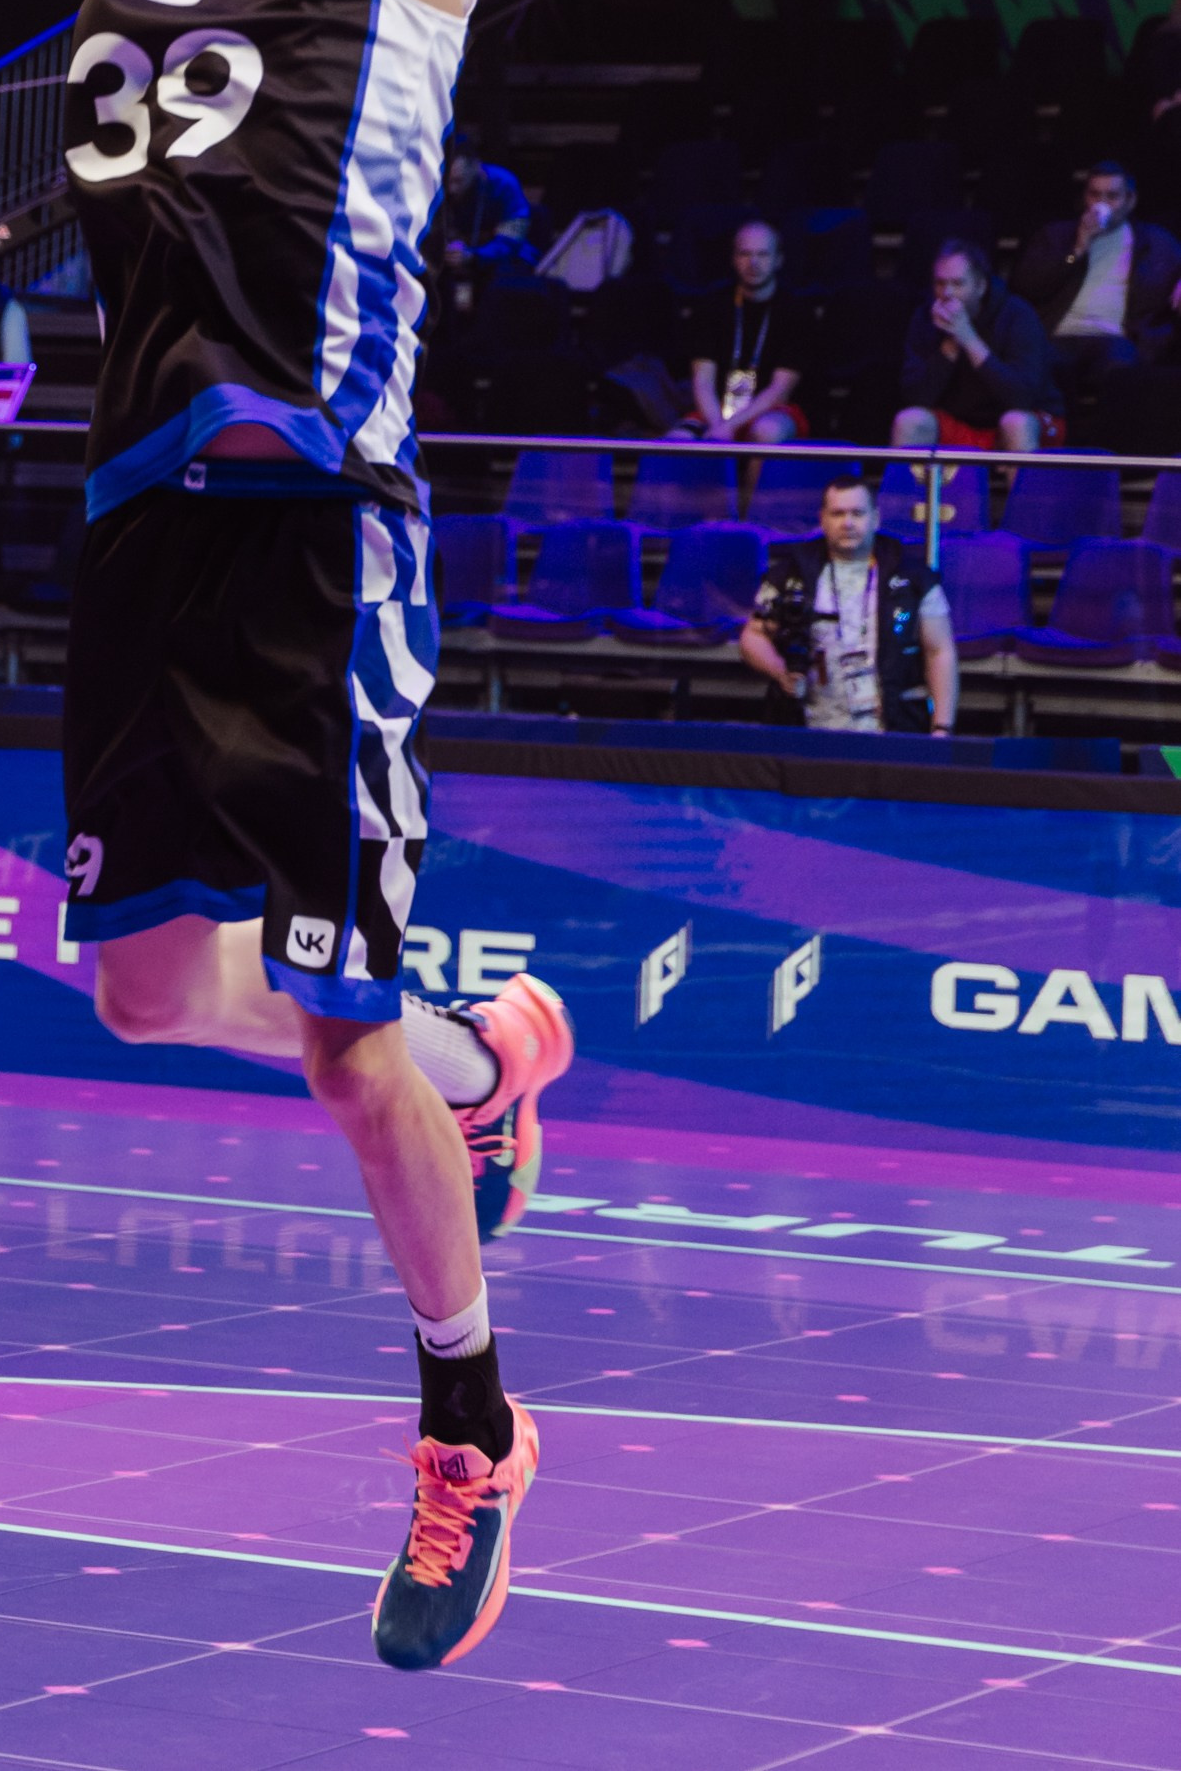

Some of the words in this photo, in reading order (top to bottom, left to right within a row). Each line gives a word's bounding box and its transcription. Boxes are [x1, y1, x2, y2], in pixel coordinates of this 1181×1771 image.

[64, 28, 264, 183] 39
[63, 832, 104, 897] 9
[402, 924, 536, 996] RE
